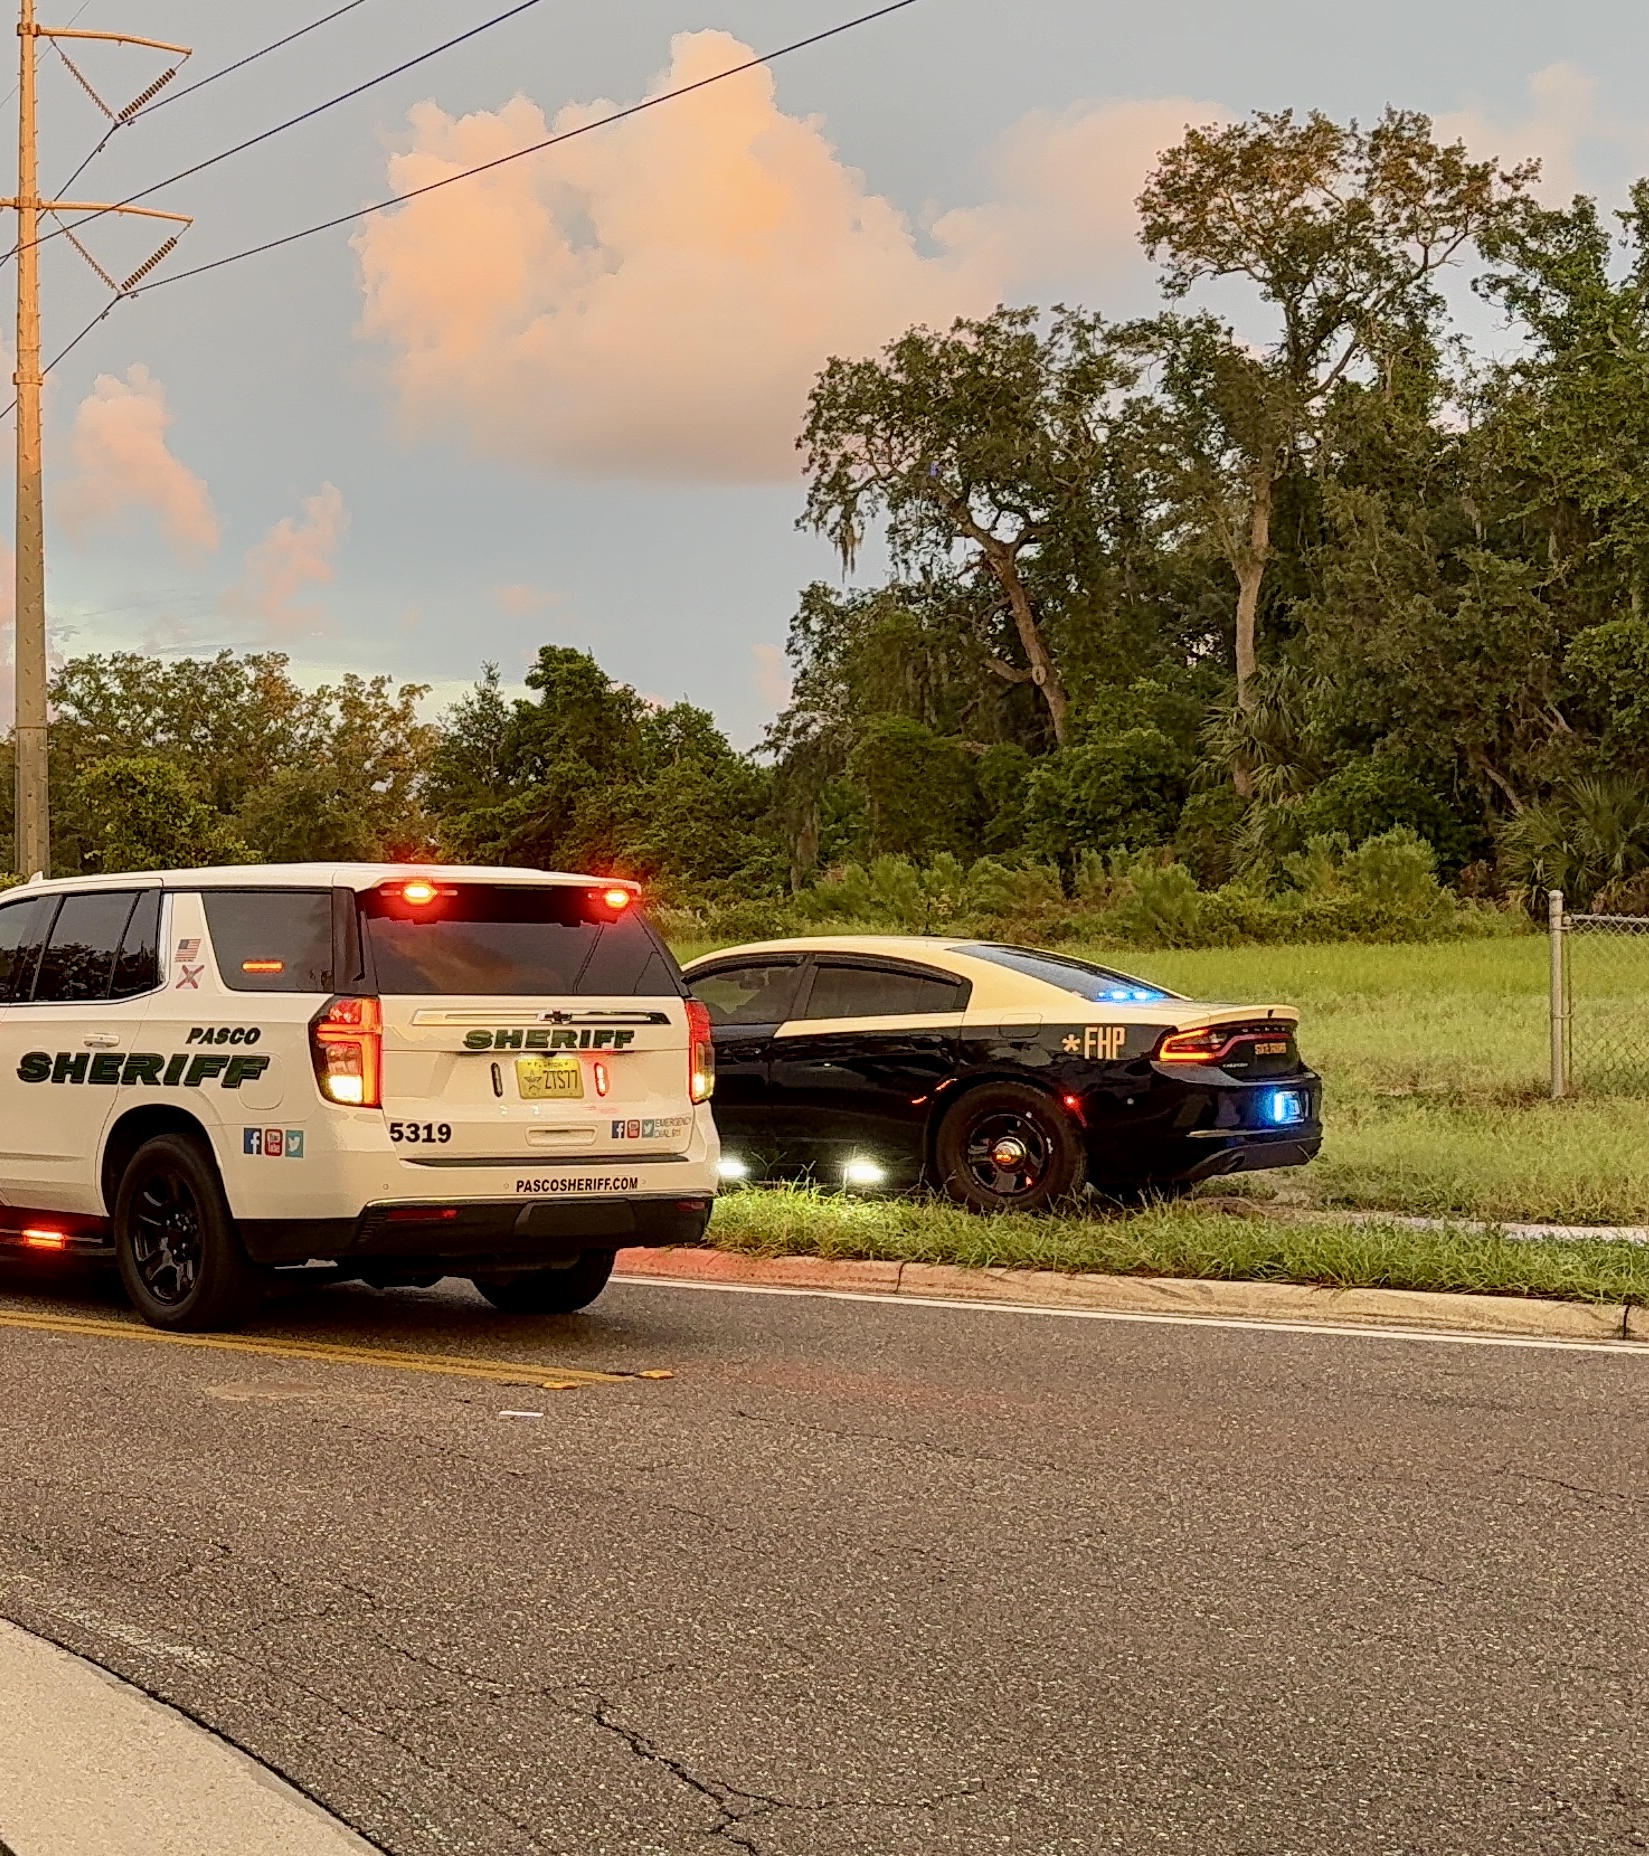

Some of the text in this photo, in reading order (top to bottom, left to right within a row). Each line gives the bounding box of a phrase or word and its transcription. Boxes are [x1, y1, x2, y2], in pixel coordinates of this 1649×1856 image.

[185, 1027, 261, 1045] PASCO
[462, 1029, 635, 1049] SHERIFF
[16, 1051, 270, 1089] SHERIFF
[389, 1122, 452, 1143] 5319
[516, 1177, 638, 1193] PASCOSHERIFF.COM
